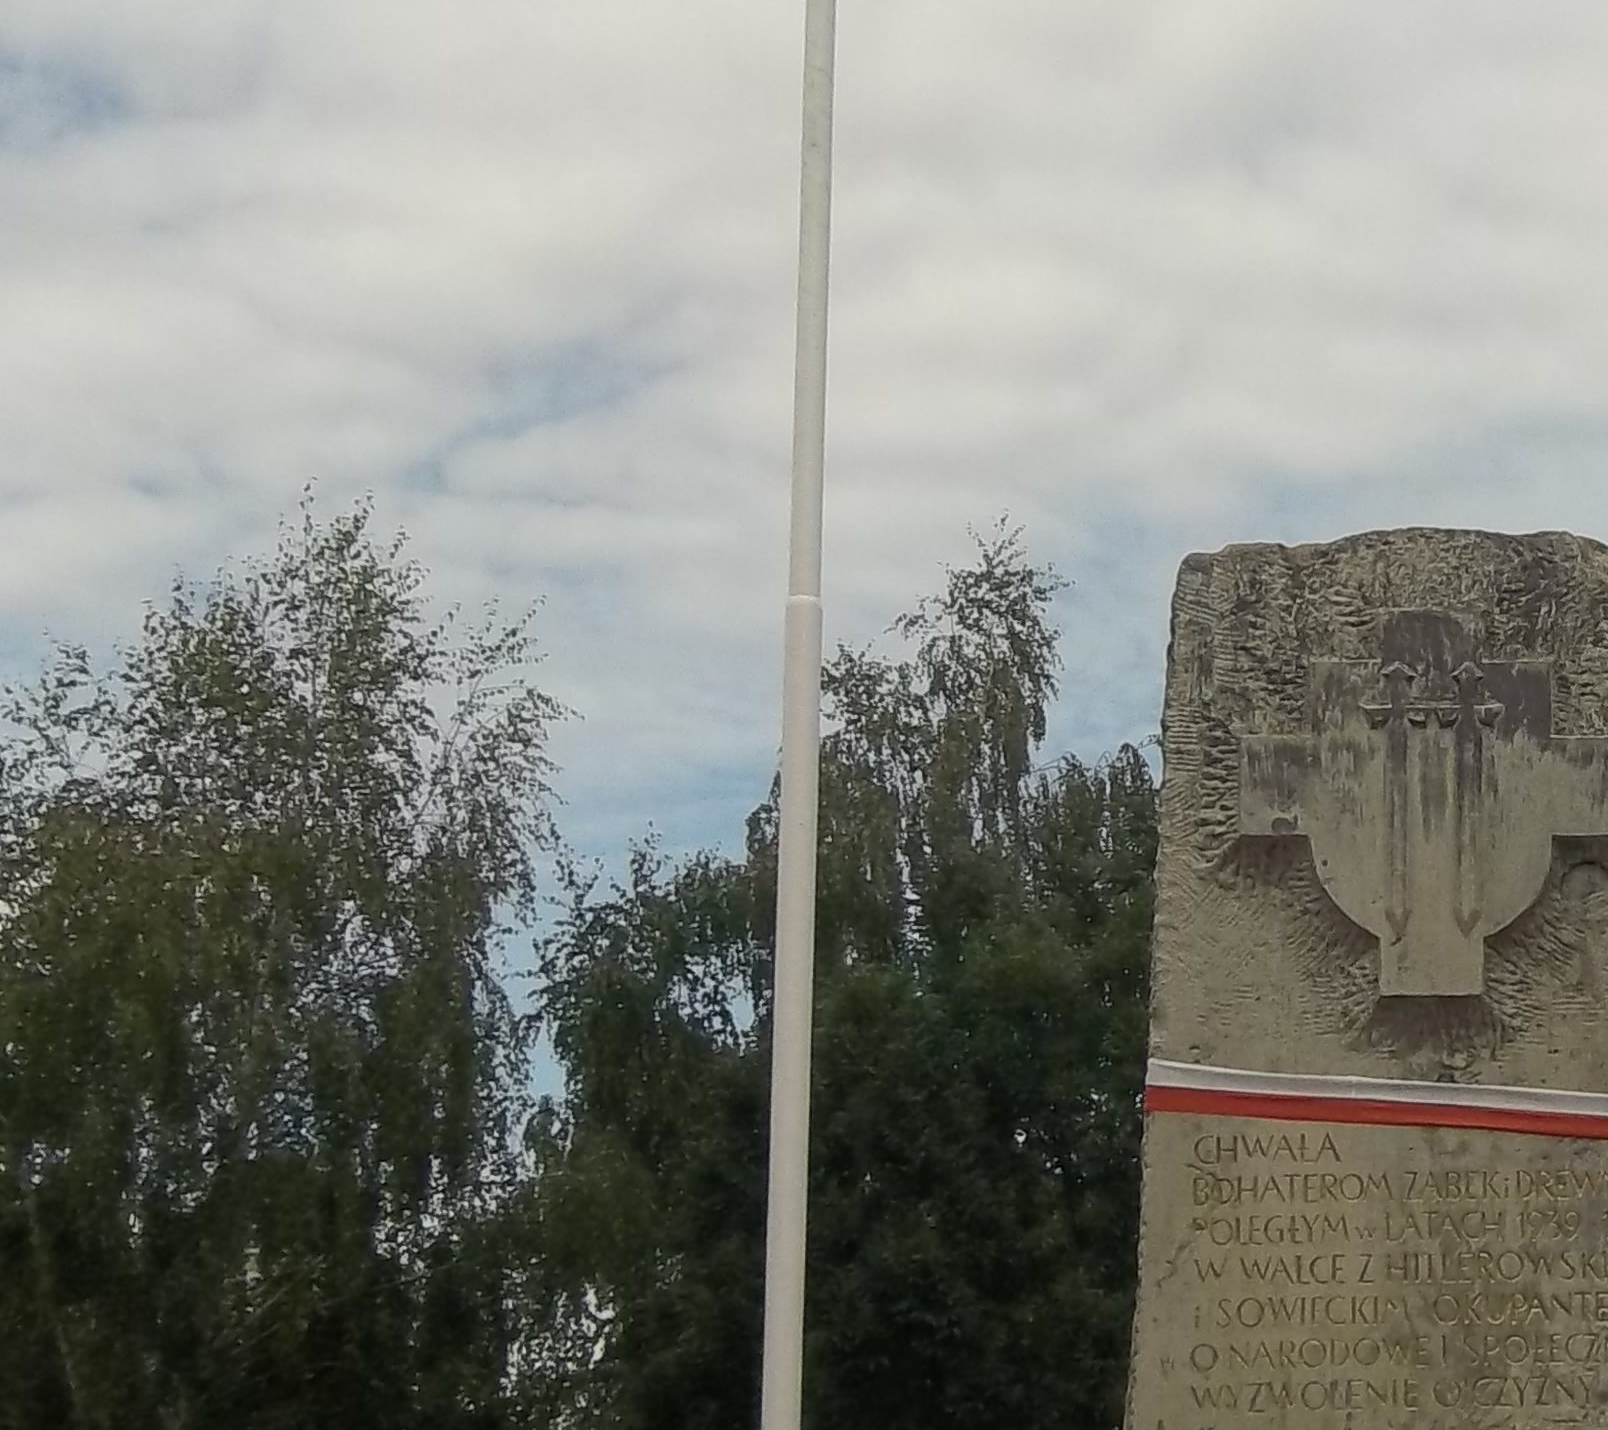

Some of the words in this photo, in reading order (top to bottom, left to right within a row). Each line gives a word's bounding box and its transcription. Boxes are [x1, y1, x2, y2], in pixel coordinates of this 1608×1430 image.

[1193, 1131, 1343, 1164] CHWAŁA
[1192, 1171, 1394, 1207] BOHATEROM
[1190, 1213, 1351, 1247] POLEGŁYM
[1384, 1210, 1505, 1244] LATACH
[1193, 1257, 1227, 1283] W
[1239, 1254, 1347, 1285] WALCE
[1357, 1253, 1375, 1285] Z
[1216, 1294, 1411, 1329] SOWIECKIM
[1189, 1342, 1219, 1373] O
[1228, 1336, 1430, 1370] NARODOWE
[1191, 1378, 1420, 1414] WYZWOLENIE
